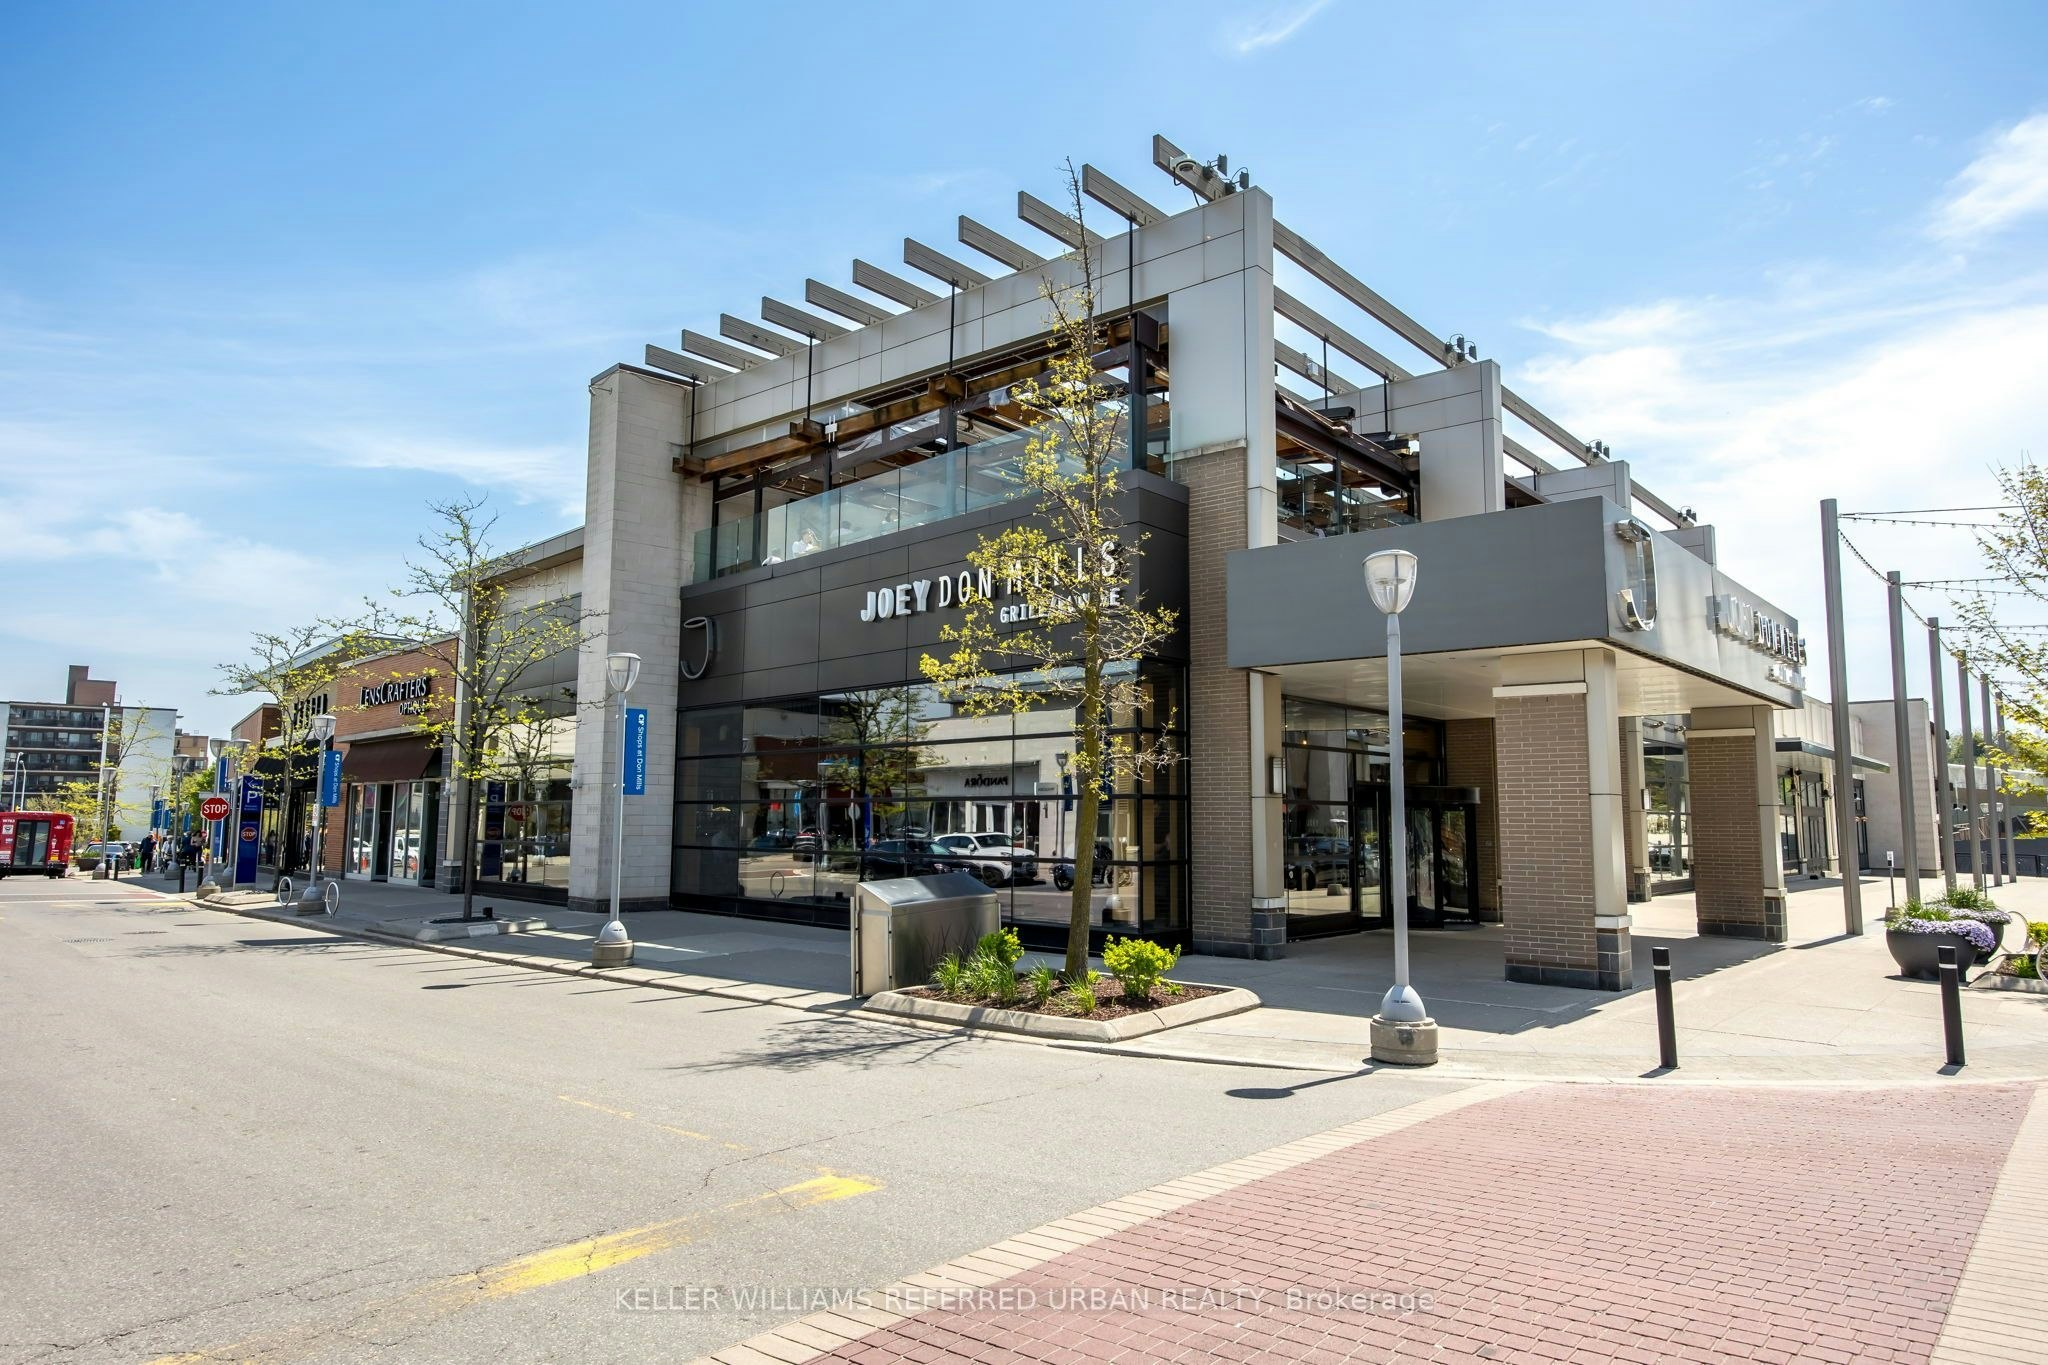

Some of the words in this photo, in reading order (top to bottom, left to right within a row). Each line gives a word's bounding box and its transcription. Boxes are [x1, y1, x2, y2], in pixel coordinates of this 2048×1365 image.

[860, 579, 932, 622] JOEY
[938, 566, 993, 607] DON
[636, 726, 645, 749] Shops
[636, 758, 644, 773] Don
[635, 774, 643, 790] Mills
[203, 804, 228, 814] STOP
